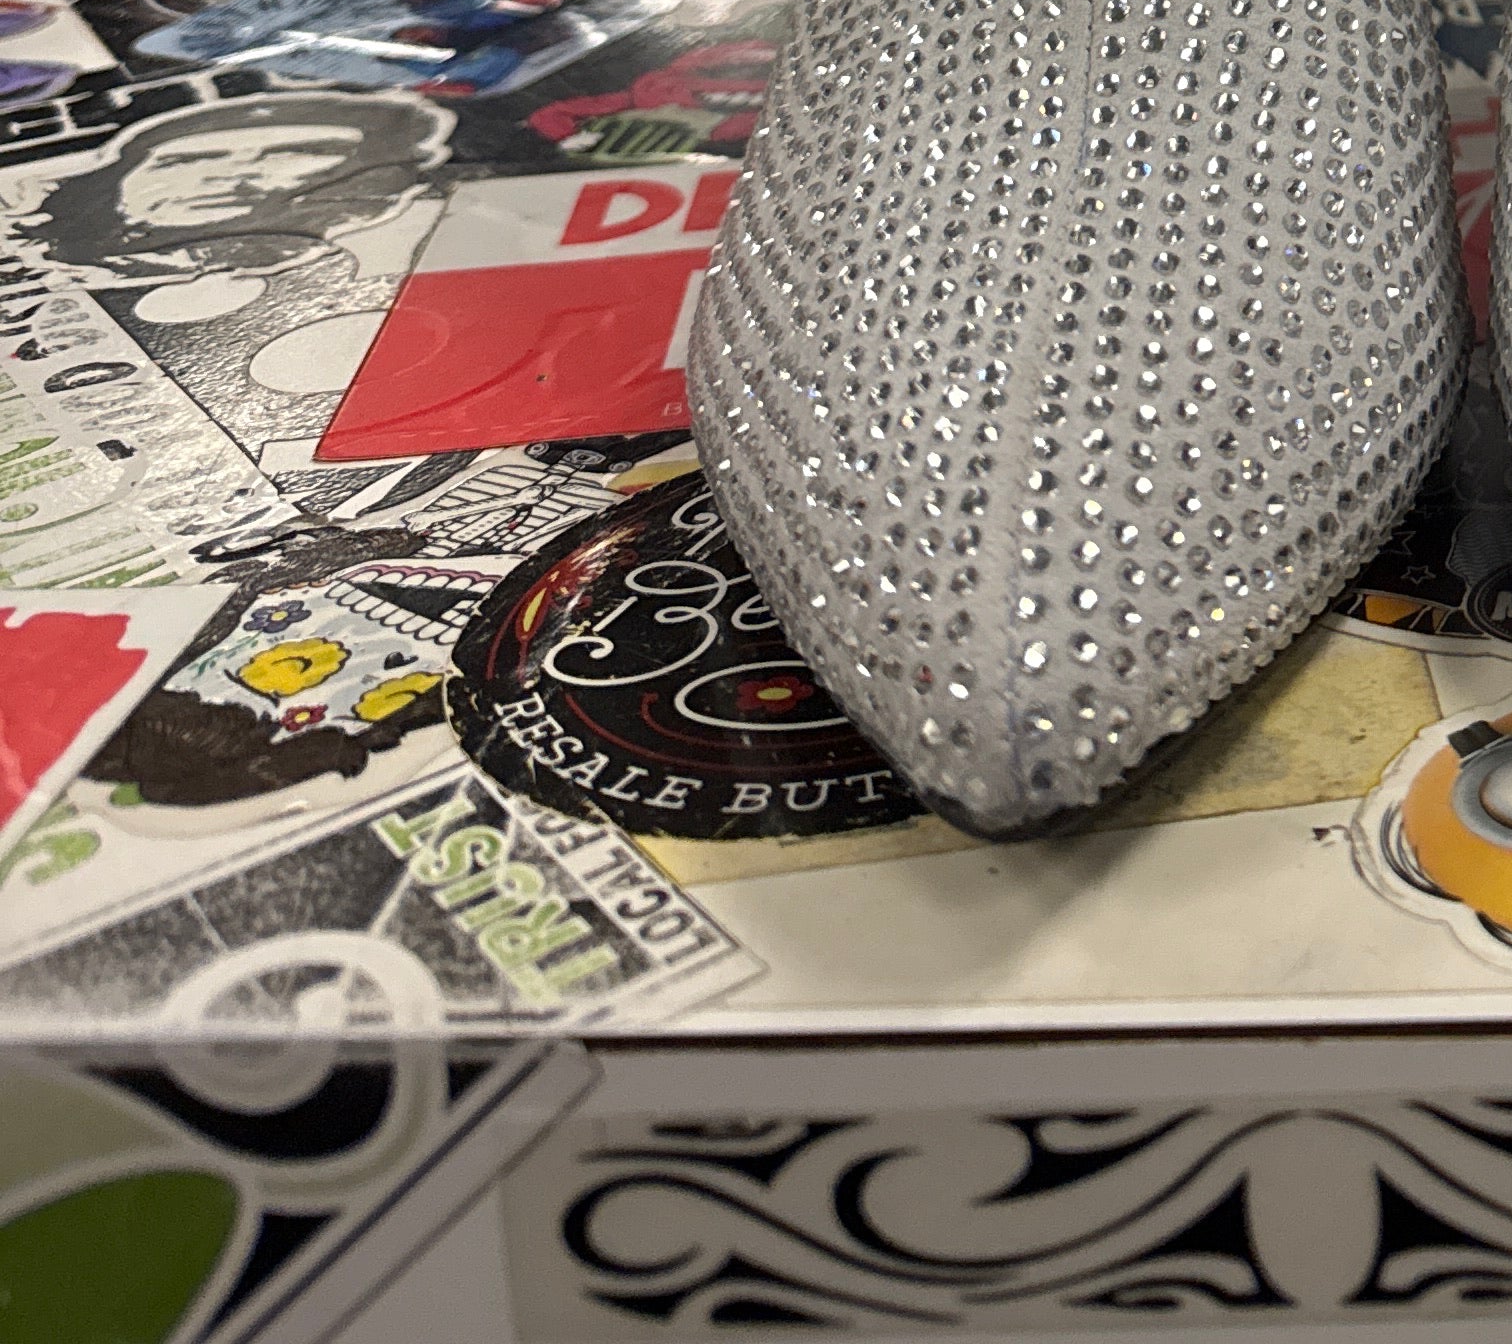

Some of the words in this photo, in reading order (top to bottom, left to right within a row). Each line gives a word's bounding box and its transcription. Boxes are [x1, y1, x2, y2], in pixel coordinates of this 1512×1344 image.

[494, 691, 704, 811] RESALE
[721, 770, 894, 813] BUT
[370, 796, 620, 1005] TRUST
[583, 845, 720, 968] LOCAL
